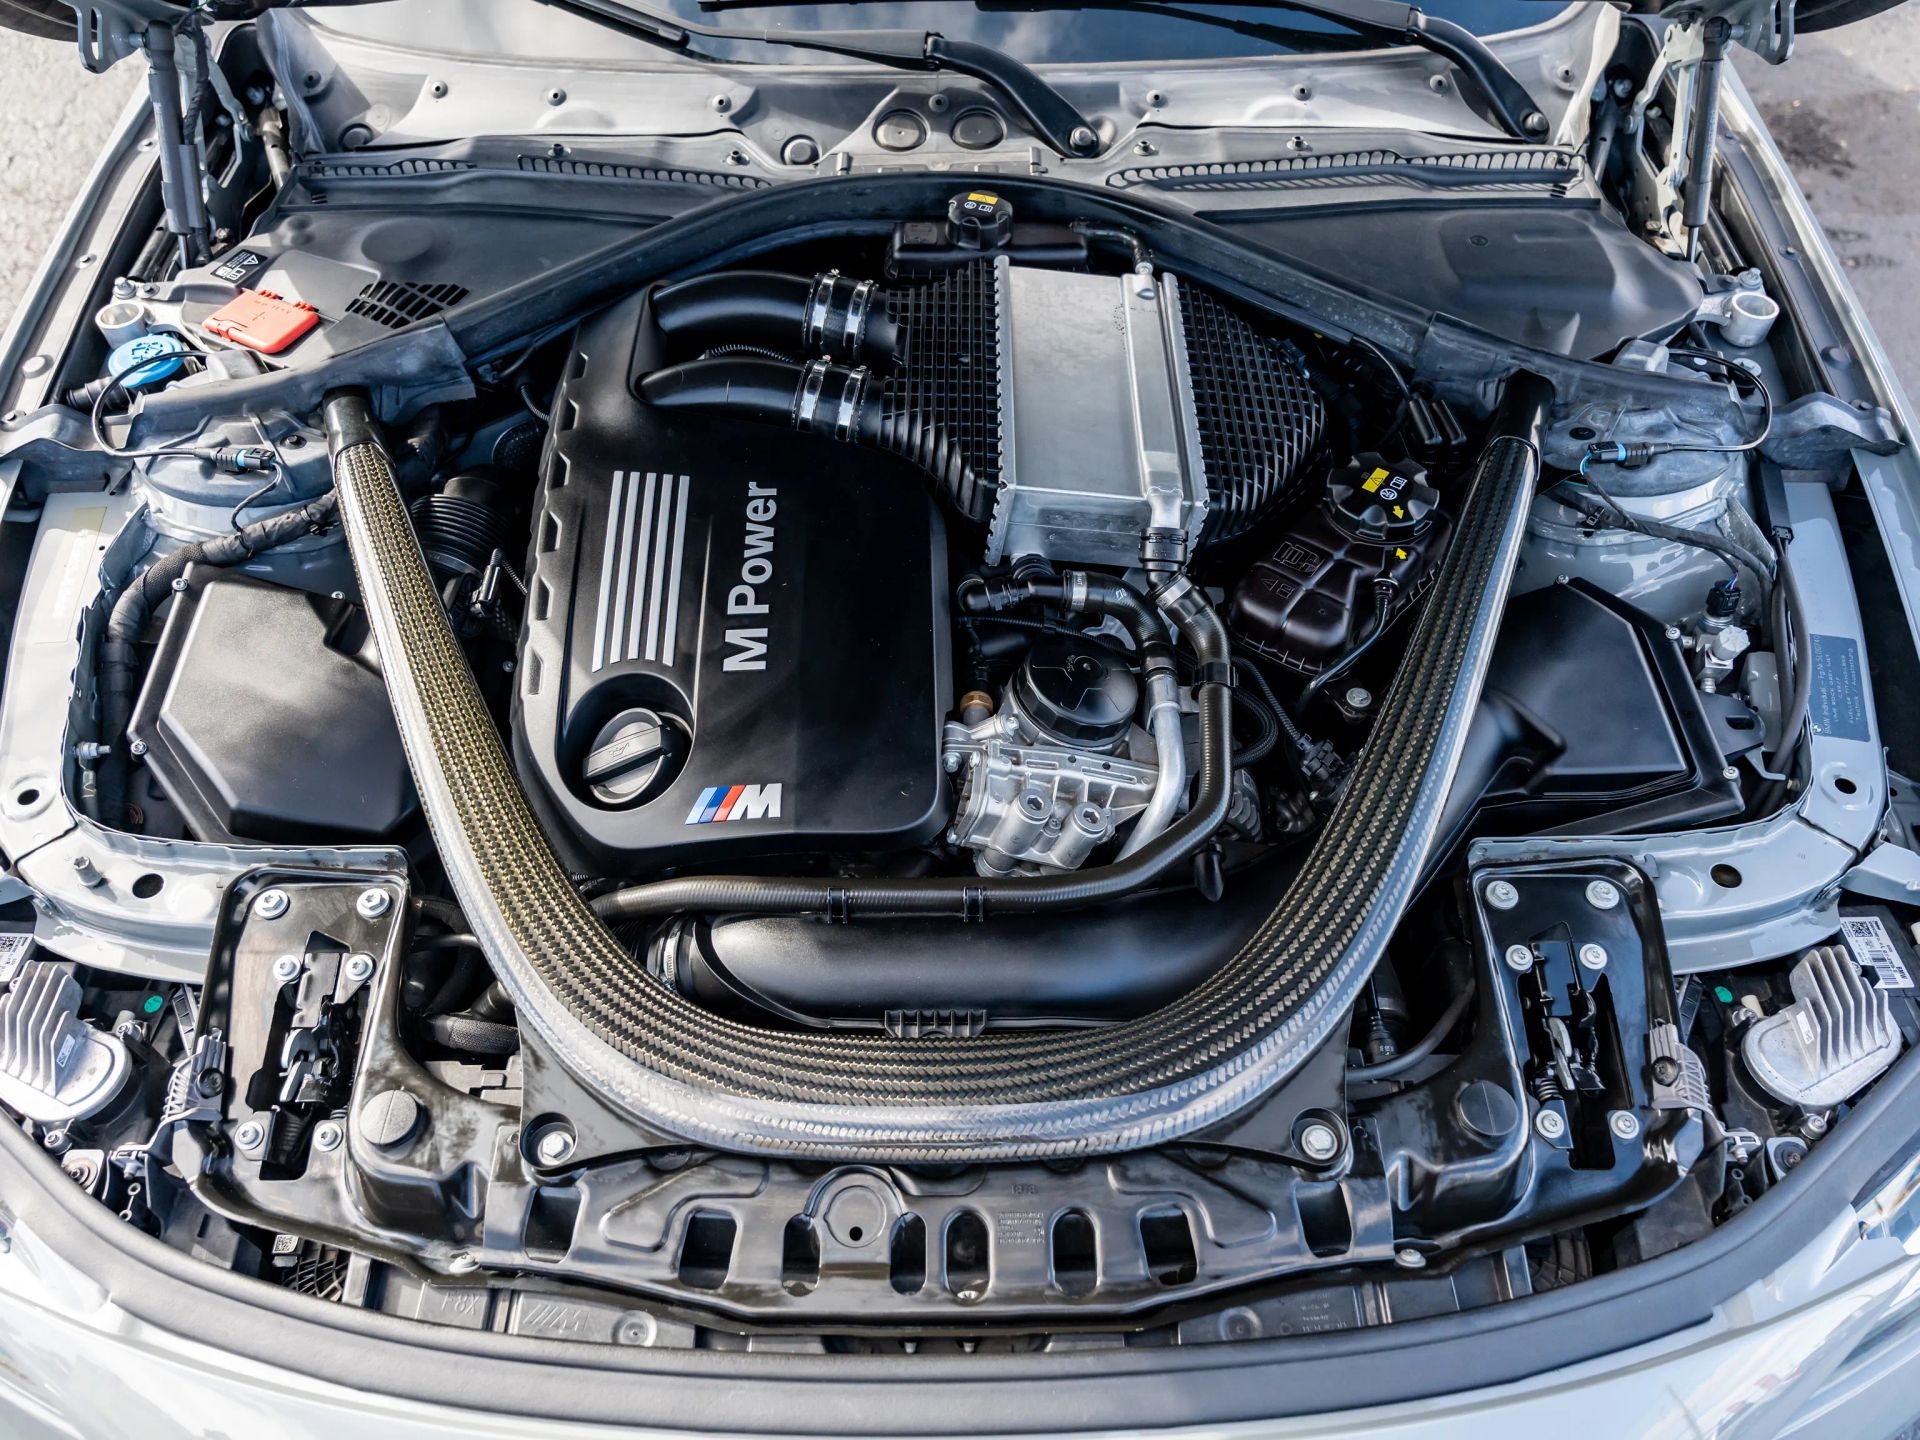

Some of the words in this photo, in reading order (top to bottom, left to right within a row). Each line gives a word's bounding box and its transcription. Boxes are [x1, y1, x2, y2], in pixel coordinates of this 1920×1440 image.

[727, 481, 777, 615] Power
[722, 627, 769, 672] M
[1823, 717, 1832, 735] BMW
[726, 783, 782, 821] M
